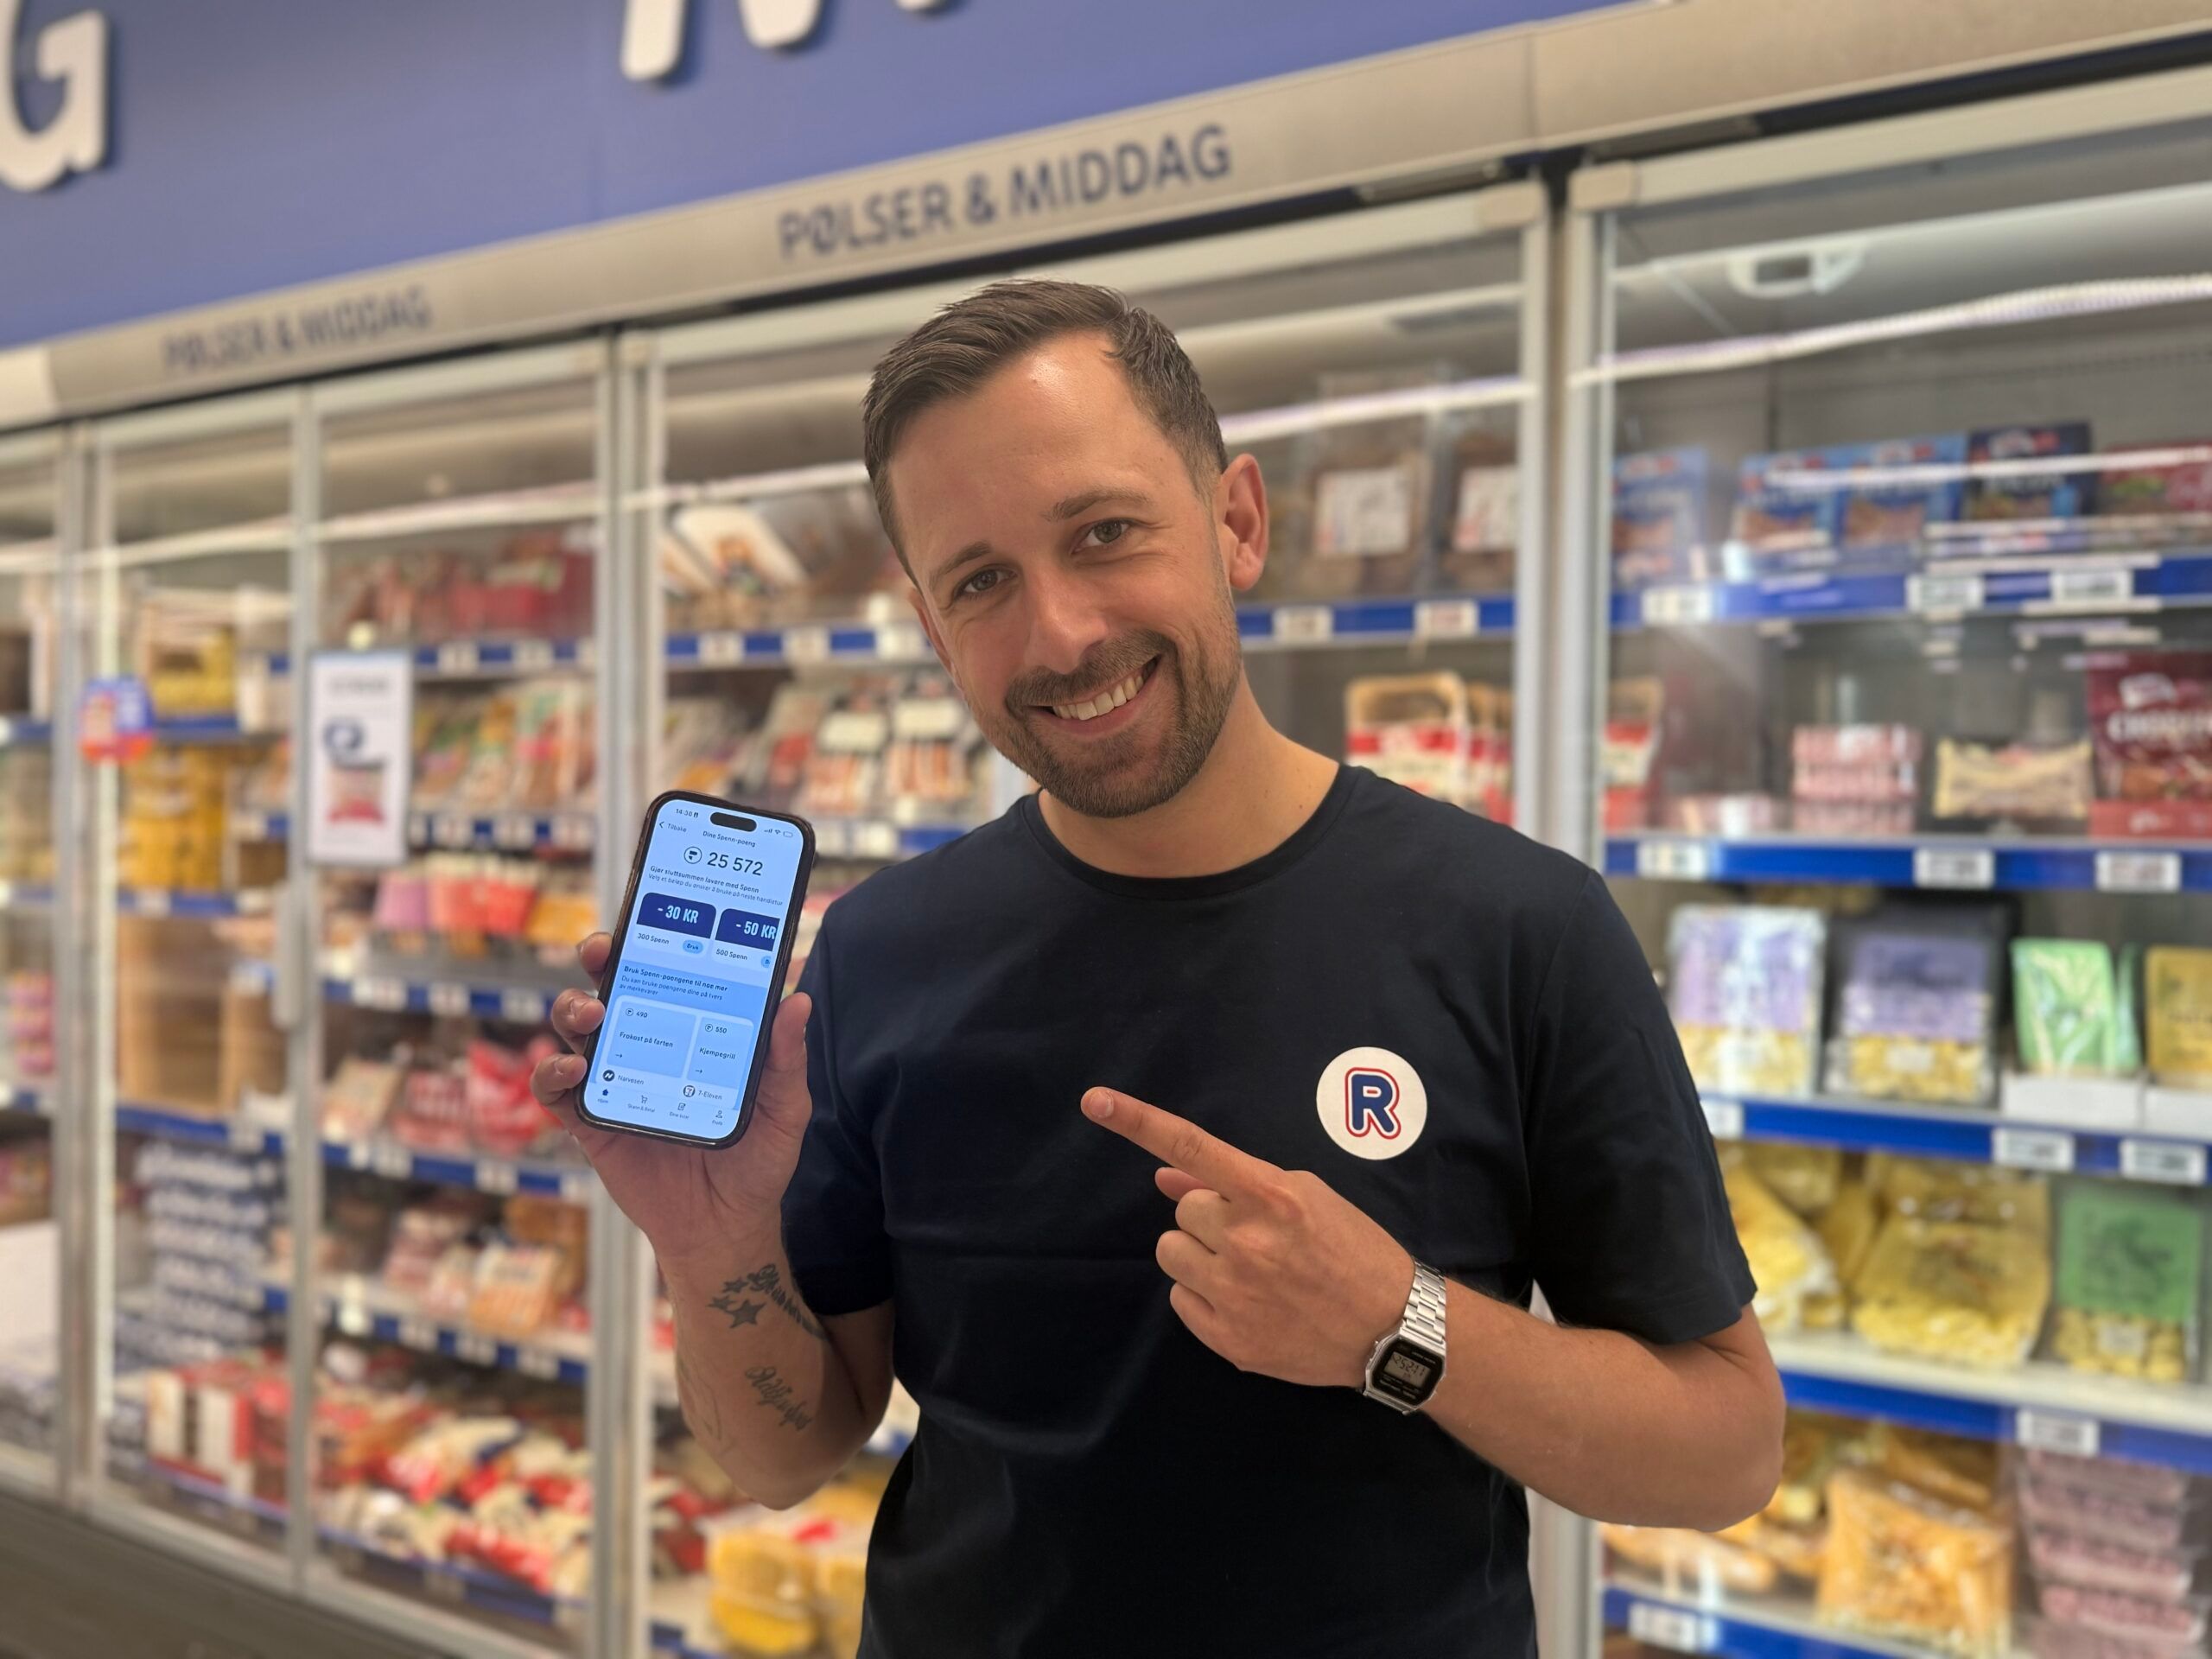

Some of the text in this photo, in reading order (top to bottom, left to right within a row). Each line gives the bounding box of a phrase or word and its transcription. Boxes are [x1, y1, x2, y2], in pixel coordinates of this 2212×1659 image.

[780, 124, 1233, 257] PØLSER & MIDDAG
[717, 834, 756, 848] Spenn-poeng
[707, 852, 764, 876] 25 572
[664, 869, 704, 882] sluttsummen
[705, 877, 724, 886] lavere
[740, 884, 760, 893] Spenn
[665, 905, 682, 919] 30
[683, 908, 700, 924] KR
[744, 921, 760, 936] 50
[761, 925, 778, 939] KR
[651, 936, 670, 945] Spenn
[729, 952, 747, 961] Spenn
[640, 969, 694, 986] Spenn-poengene
[658, 982, 687, 994] poengene
[620, 1032, 644, 1041] Frokost
[653, 1039, 674, 1047] farten
[699, 1047, 736, 1060] Kjempegrill
[618, 1075, 645, 1084] Narvesen
[698, 1090, 722, 1100] 7-Eleven
[1344, 1066, 1402, 1140] R
